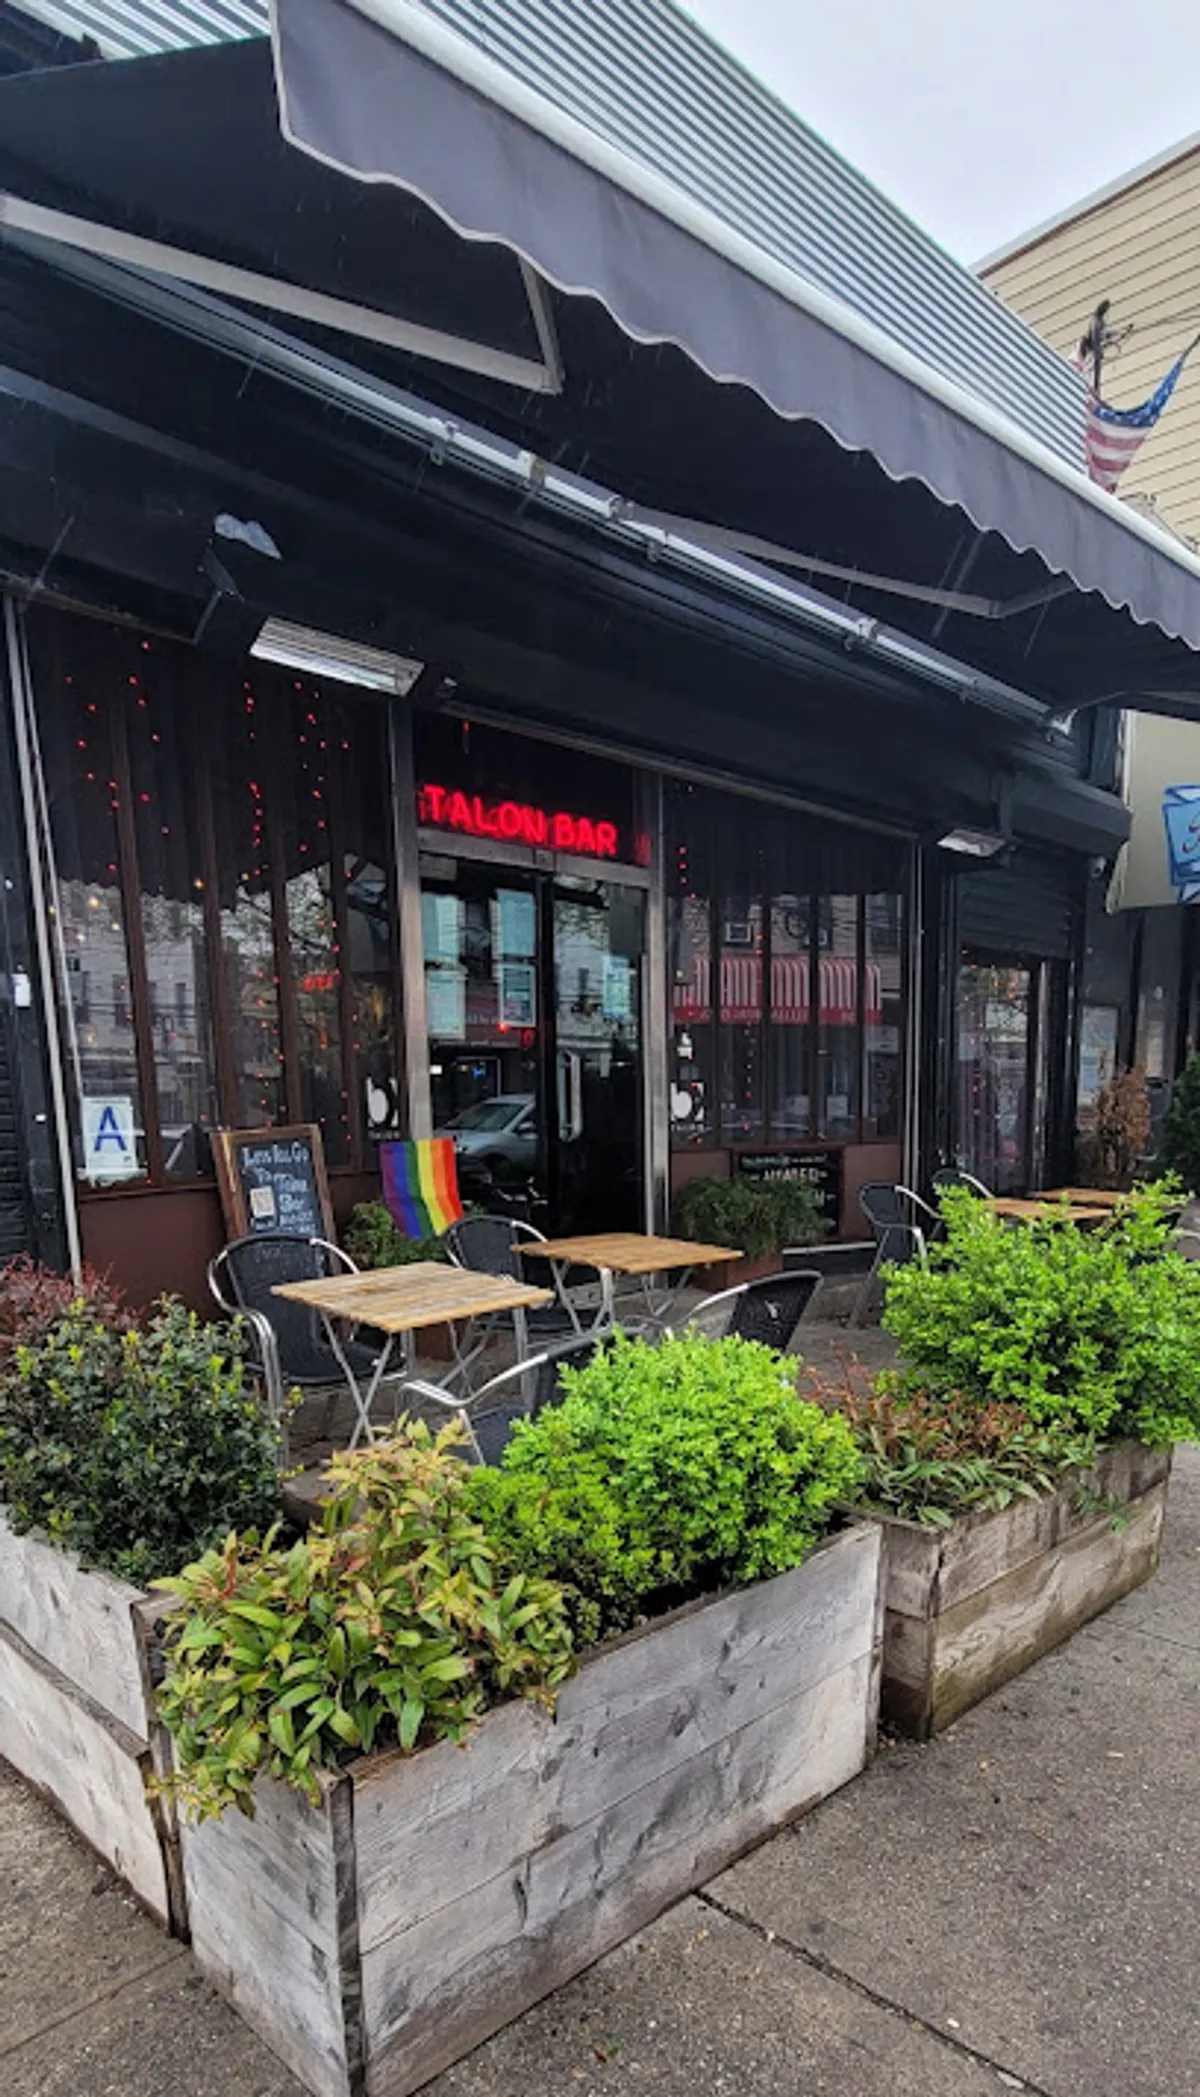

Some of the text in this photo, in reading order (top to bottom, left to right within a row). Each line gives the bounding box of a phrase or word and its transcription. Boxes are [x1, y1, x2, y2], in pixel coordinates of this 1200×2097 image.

[423, 783, 618, 855] TALON BAR
[94, 1105, 127, 1152] A
